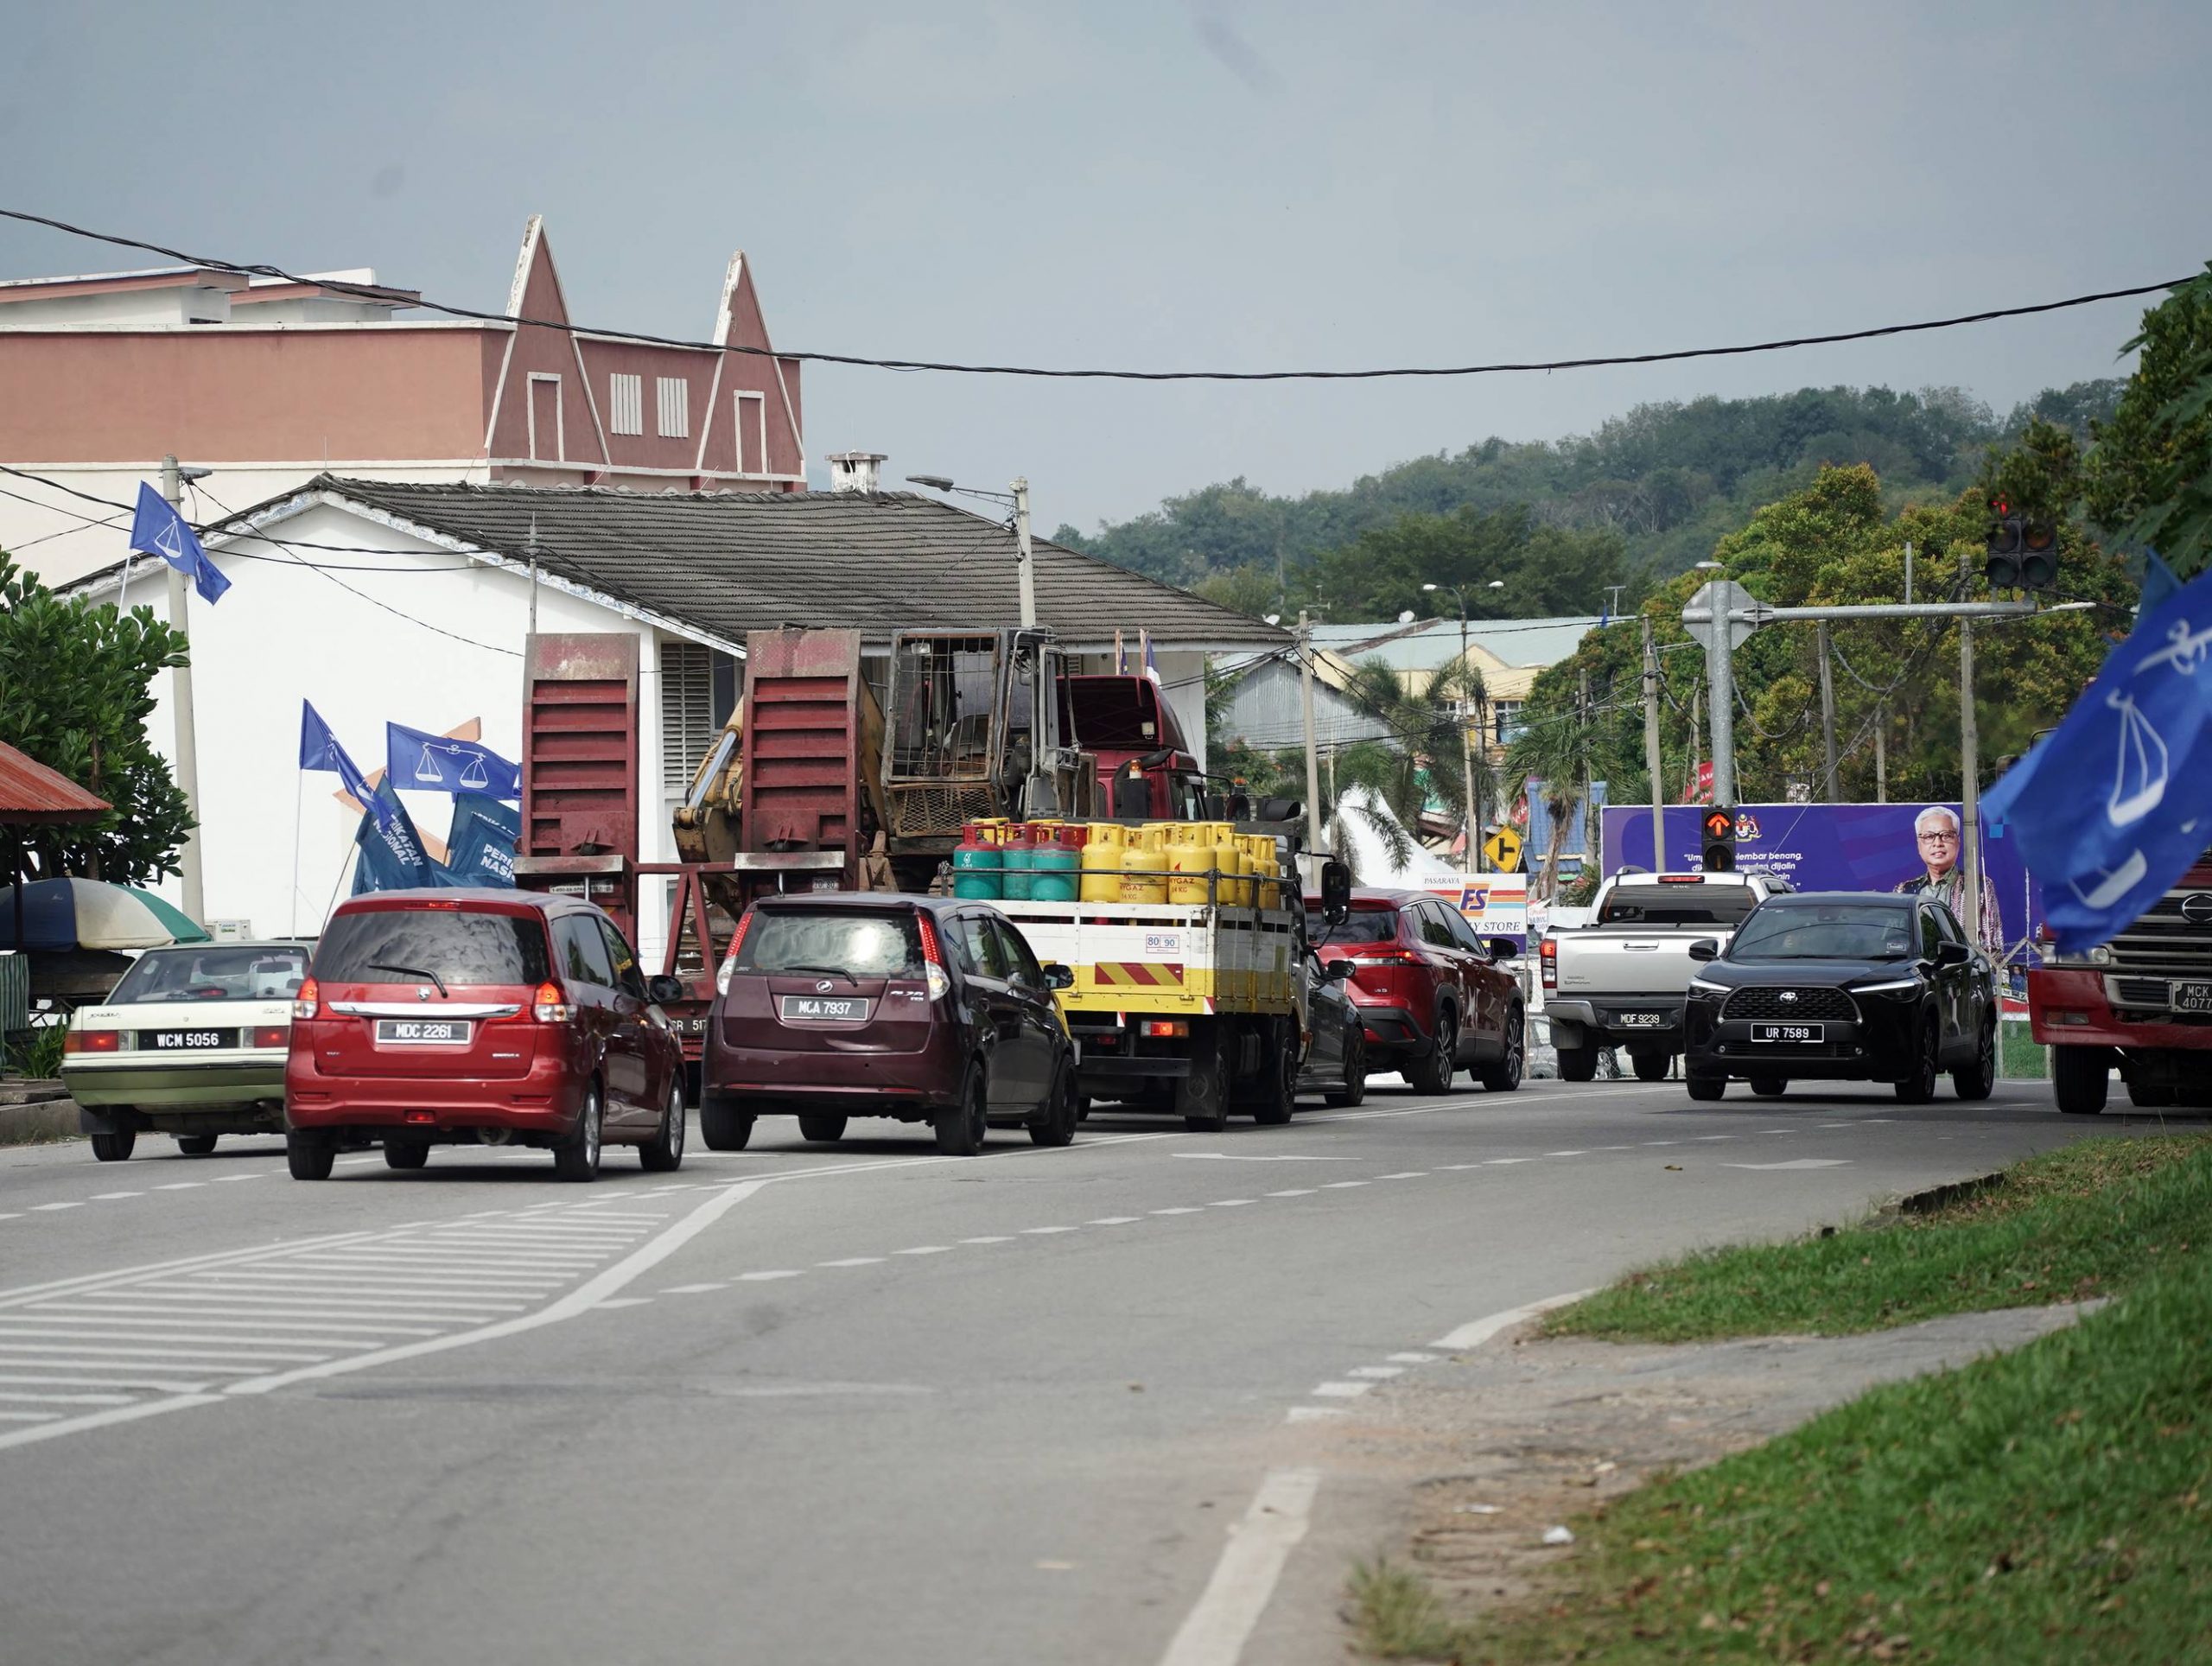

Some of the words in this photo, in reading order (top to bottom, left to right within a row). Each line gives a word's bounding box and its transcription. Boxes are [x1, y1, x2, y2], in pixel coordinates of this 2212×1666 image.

[372, 818, 410, 865] NSIONAL
[1735, 852, 1767, 861] lembar
[1769, 852, 1803, 861] benang.
[1770, 862, 1796, 871] dijalin
[1459, 888, 1489, 911] FS
[1484, 921, 1521, 932] STORE
[1147, 937, 1160, 946] 80
[1164, 938, 1175, 947] 90
[2187, 986, 2209, 997] MCK
[798, 1001, 821, 1014] MCA
[823, 1002, 851, 1015] 7937
[2183, 997, 2212, 1009] 4077
[1620, 1014, 1637, 1024] MDF
[1638, 1014, 1660, 1024] 9239
[396, 1024, 421, 1038] MDC
[423, 1024, 452, 1039] 2261
[1765, 1027, 1780, 1039] UR
[1783, 1027, 1809, 1039] 7589
[156, 1033, 183, 1047] WCM
[186, 1033, 219, 1046] 5056
